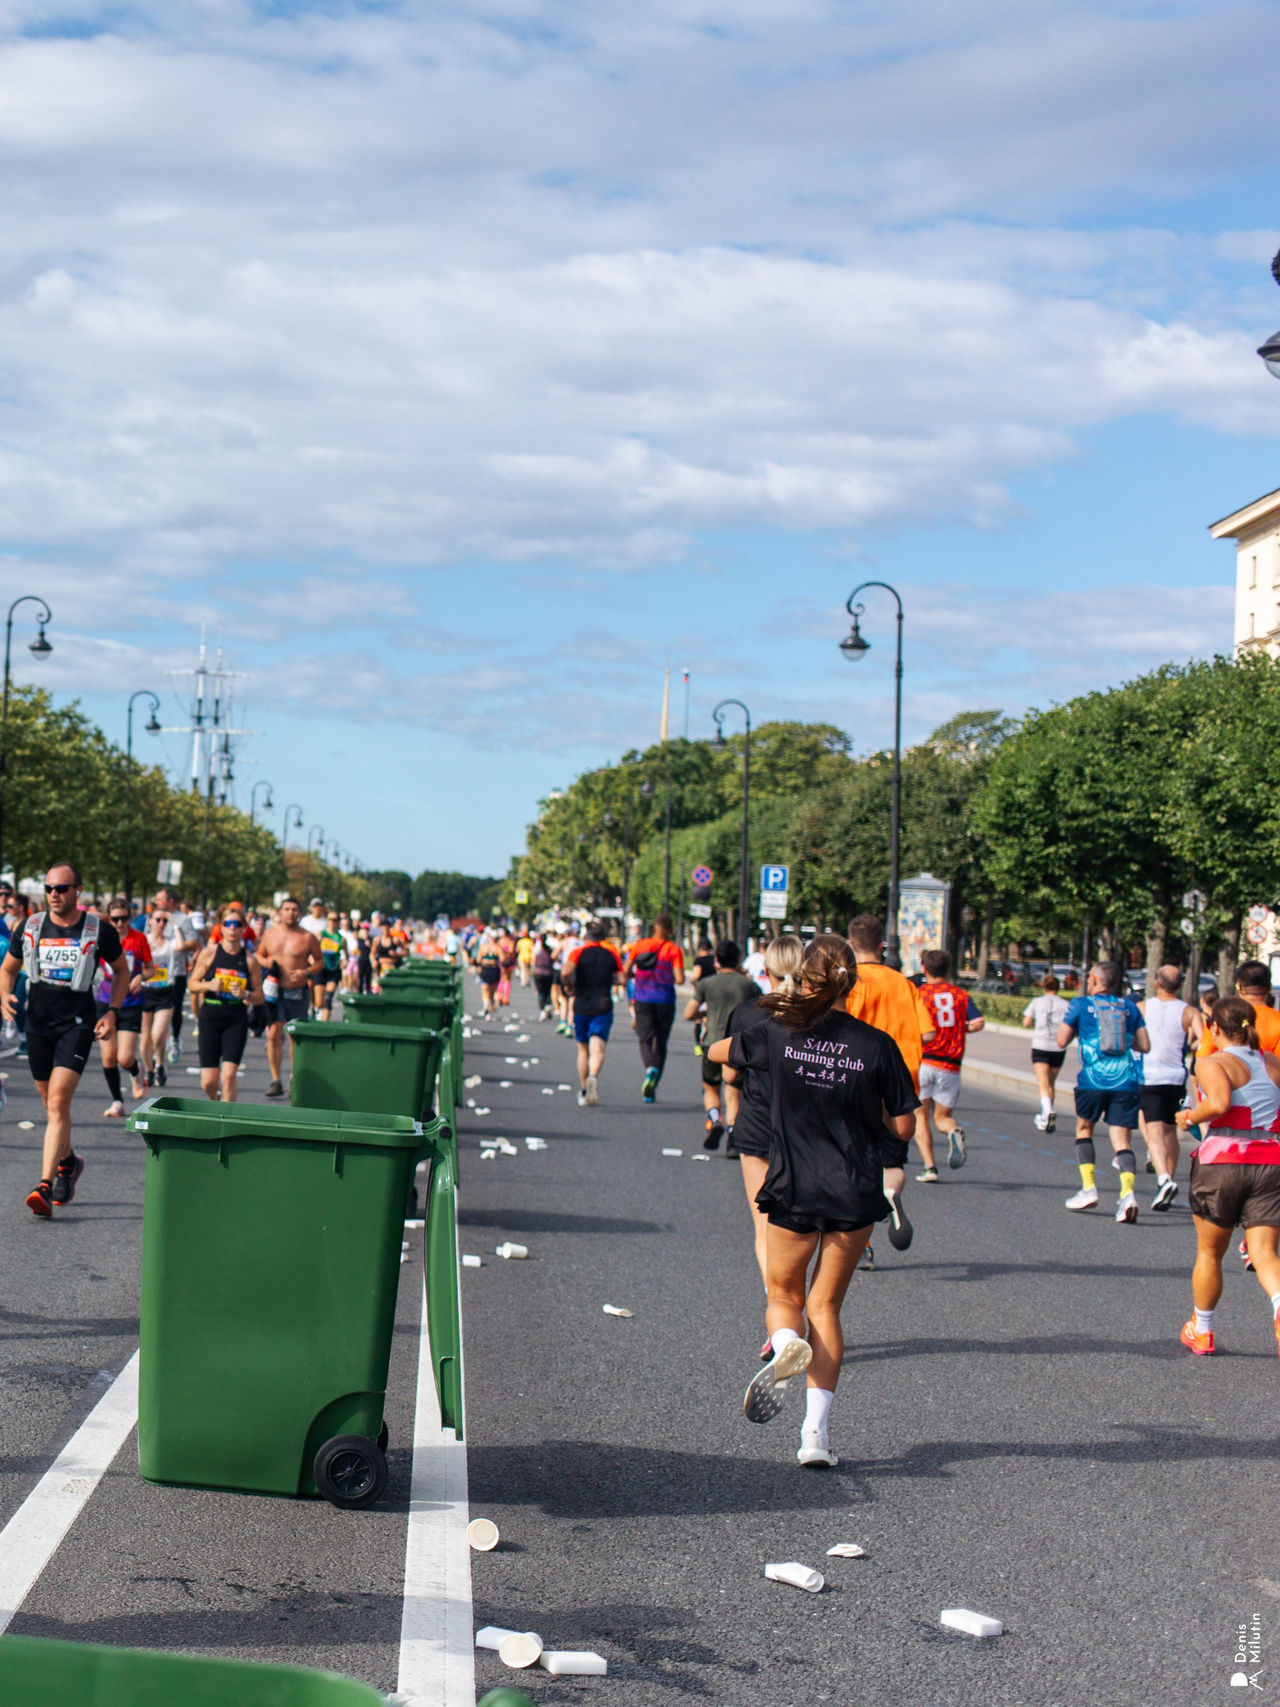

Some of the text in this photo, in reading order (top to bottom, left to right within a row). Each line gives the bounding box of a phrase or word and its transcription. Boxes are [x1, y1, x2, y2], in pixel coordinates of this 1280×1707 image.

[768, 868, 784, 889] P
[45, 950, 78, 962] 4755
[933, 992, 956, 1027] 8
[803, 1037, 848, 1055] SAINT
[784, 1045, 865, 1072] Running club
